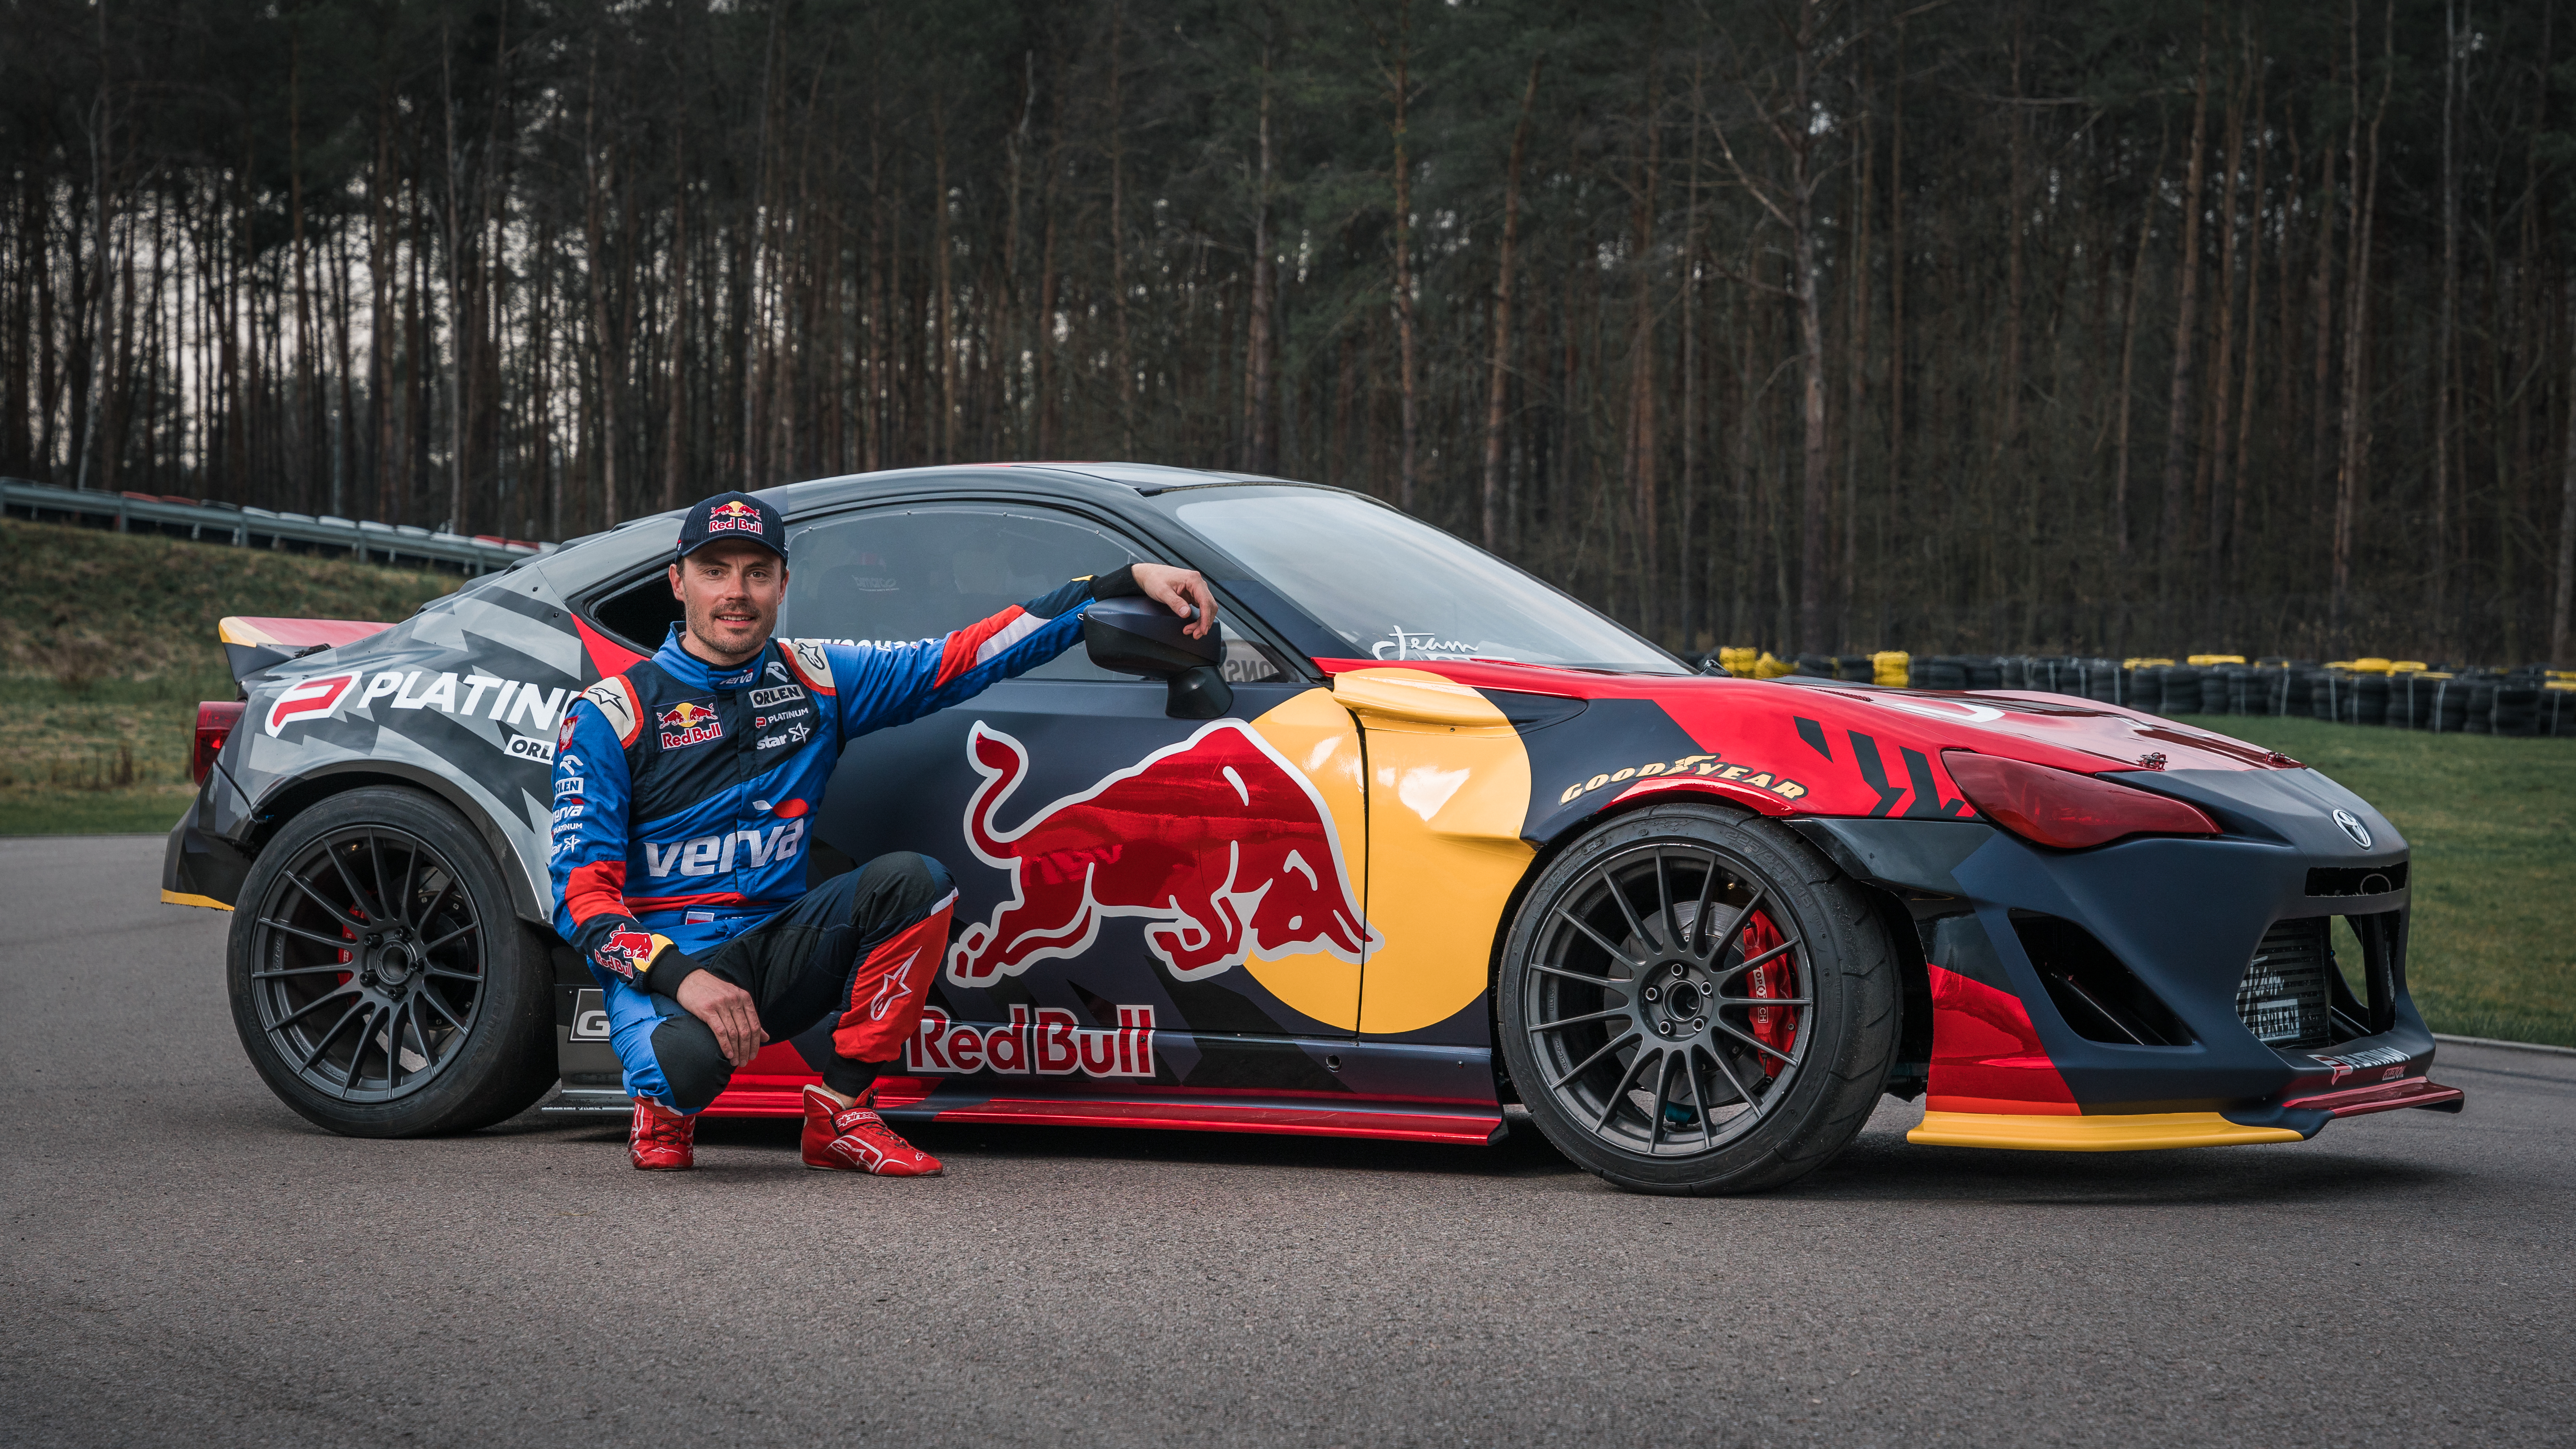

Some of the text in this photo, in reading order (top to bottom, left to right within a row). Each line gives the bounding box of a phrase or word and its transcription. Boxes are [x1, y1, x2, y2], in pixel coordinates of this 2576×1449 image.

[709, 517, 762, 534] Red Bull
[720, 672, 753, 684] verva
[357, 671, 587, 730] PLATIN
[753, 687, 801, 705] ORLEN
[768, 708, 809, 723] PLATINUM
[661, 722, 723, 749] Red Bull
[757, 734, 787, 750] star
[512, 739, 554, 761] ORL
[556, 780, 579, 795] RLEN
[554, 823, 582, 835] PLATINUM
[643, 818, 804, 877] verva
[1724, 826, 1815, 909] 225/40 R 18
[595, 949, 633, 979] Red Bull
[906, 1004, 1155, 1078] Red Bull
[2333, 1047, 2410, 1068] PLATINUM
[836, 1112, 882, 1127] alpinesta
